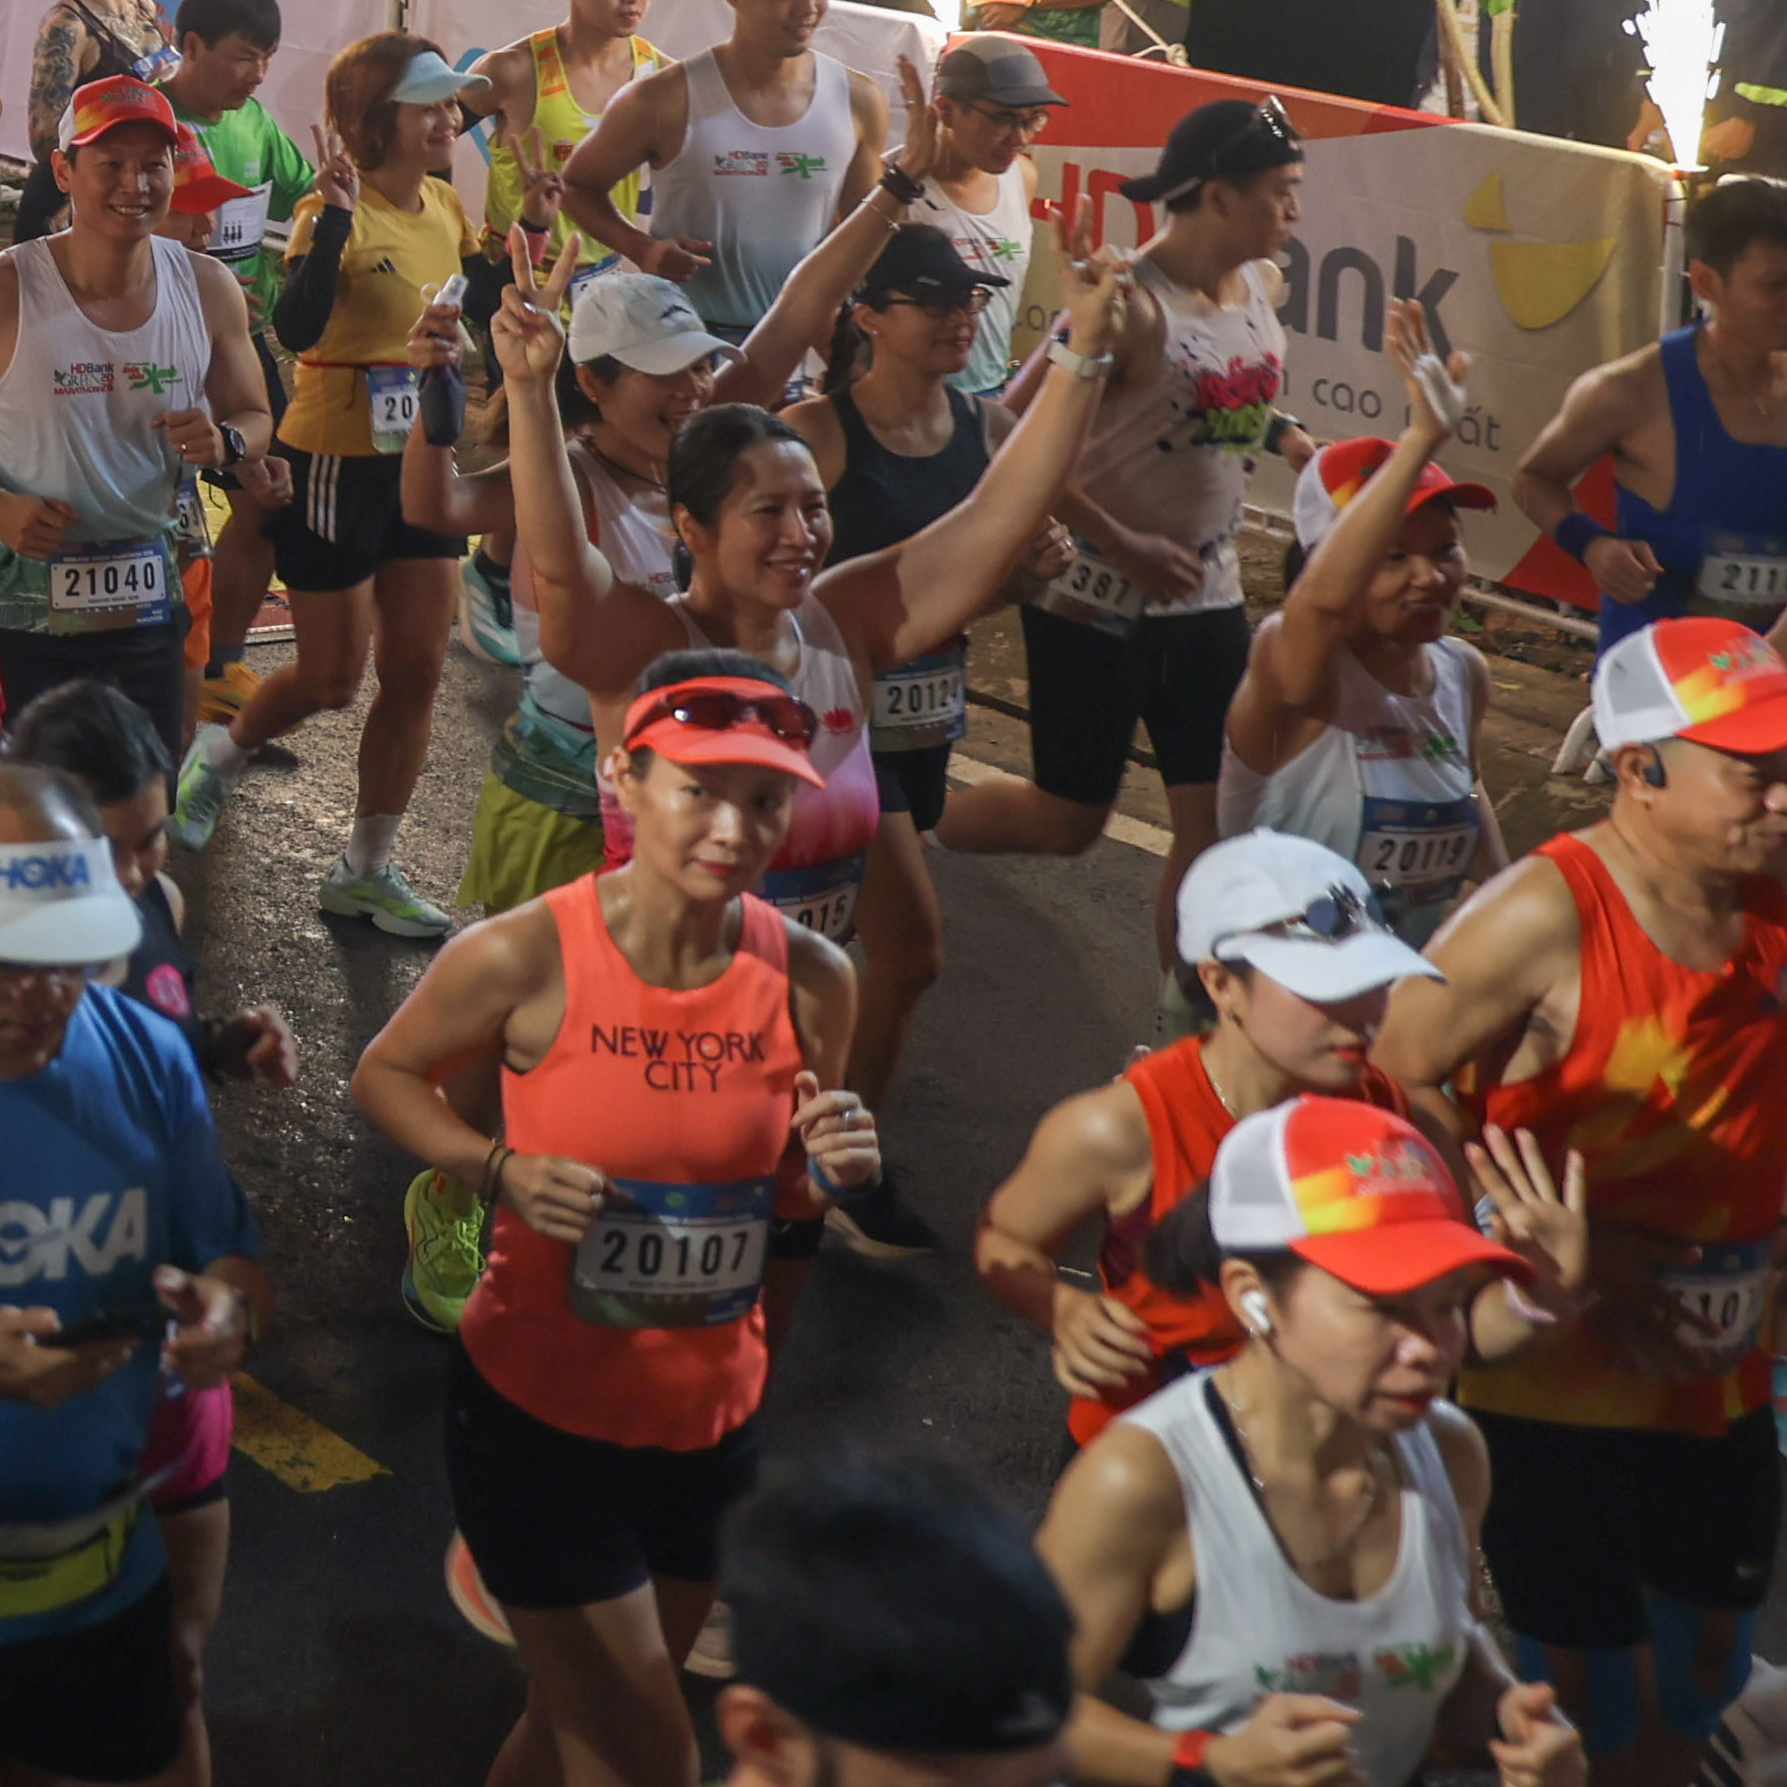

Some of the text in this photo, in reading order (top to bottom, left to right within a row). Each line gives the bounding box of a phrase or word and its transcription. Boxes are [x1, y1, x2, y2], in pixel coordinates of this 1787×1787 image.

[70, 362, 115, 375] HDBank
[1312, 377, 1383, 420] cao
[64, 561, 156, 597] 21040
[590, 1022, 765, 1062] NEW YORK
[643, 1060, 725, 1093] CITY
[601, 1229, 750, 1279] 20107
